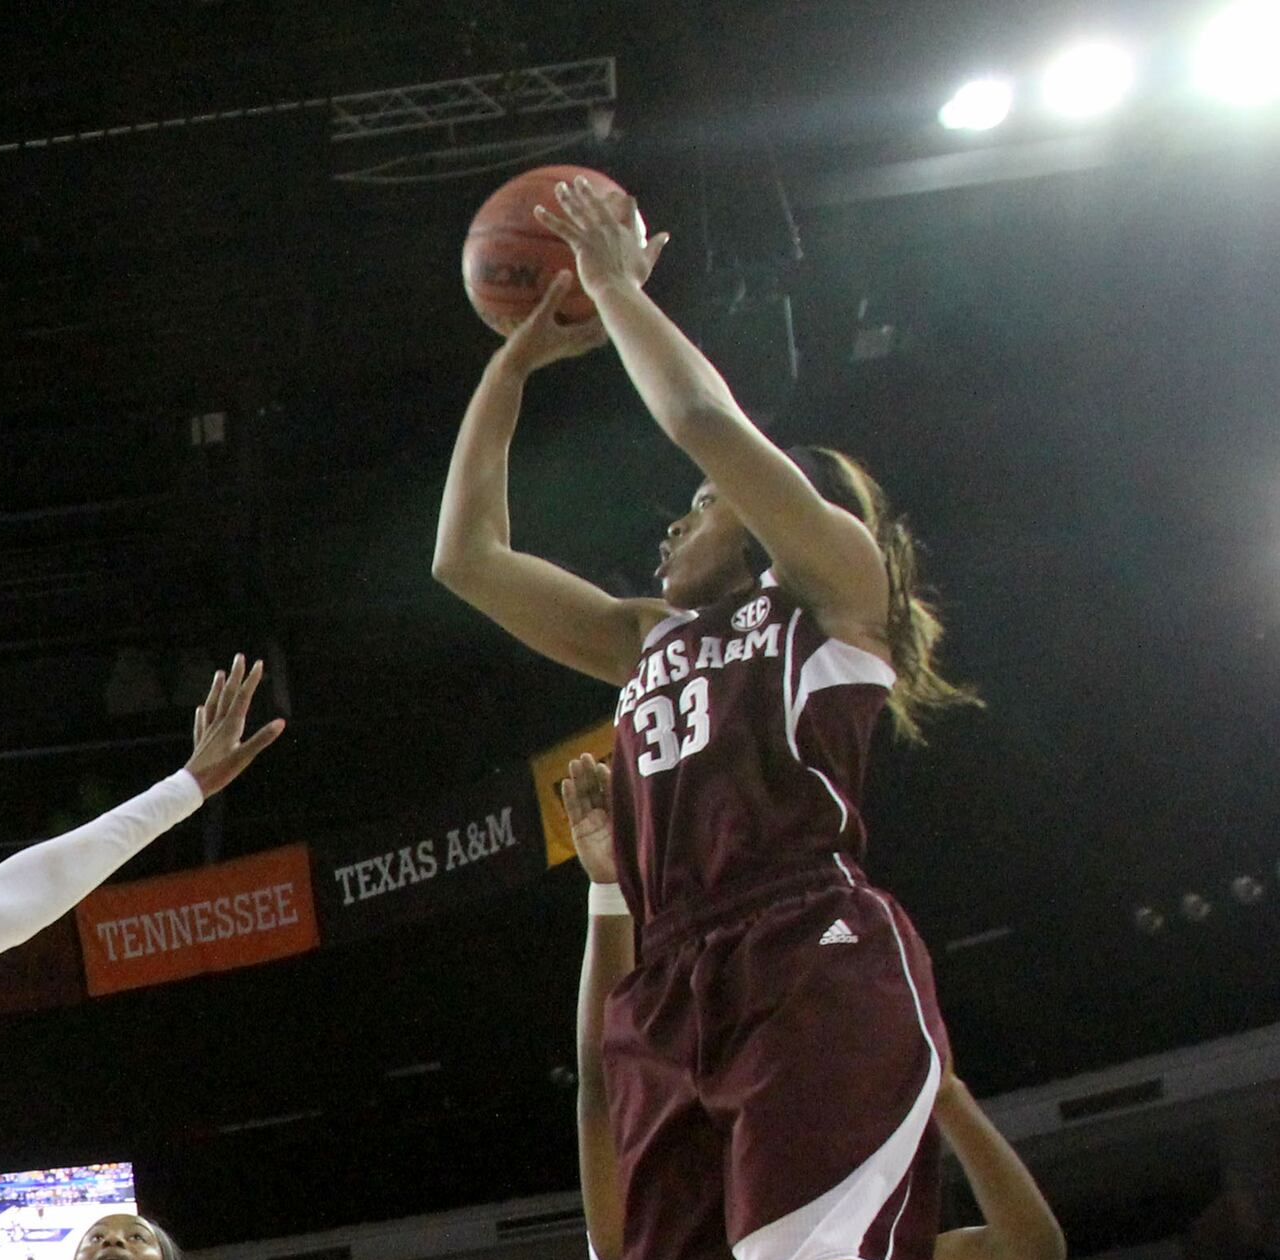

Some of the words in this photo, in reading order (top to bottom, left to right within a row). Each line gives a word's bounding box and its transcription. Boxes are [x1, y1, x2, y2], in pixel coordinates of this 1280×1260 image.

[695, 623, 782, 669] A&M
[733, 597, 769, 629] SEC
[633, 676, 710, 777] 33
[335, 838, 438, 906] TEXAS
[445, 807, 517, 872] A&M
[96, 882, 299, 962] TENNESSEE
